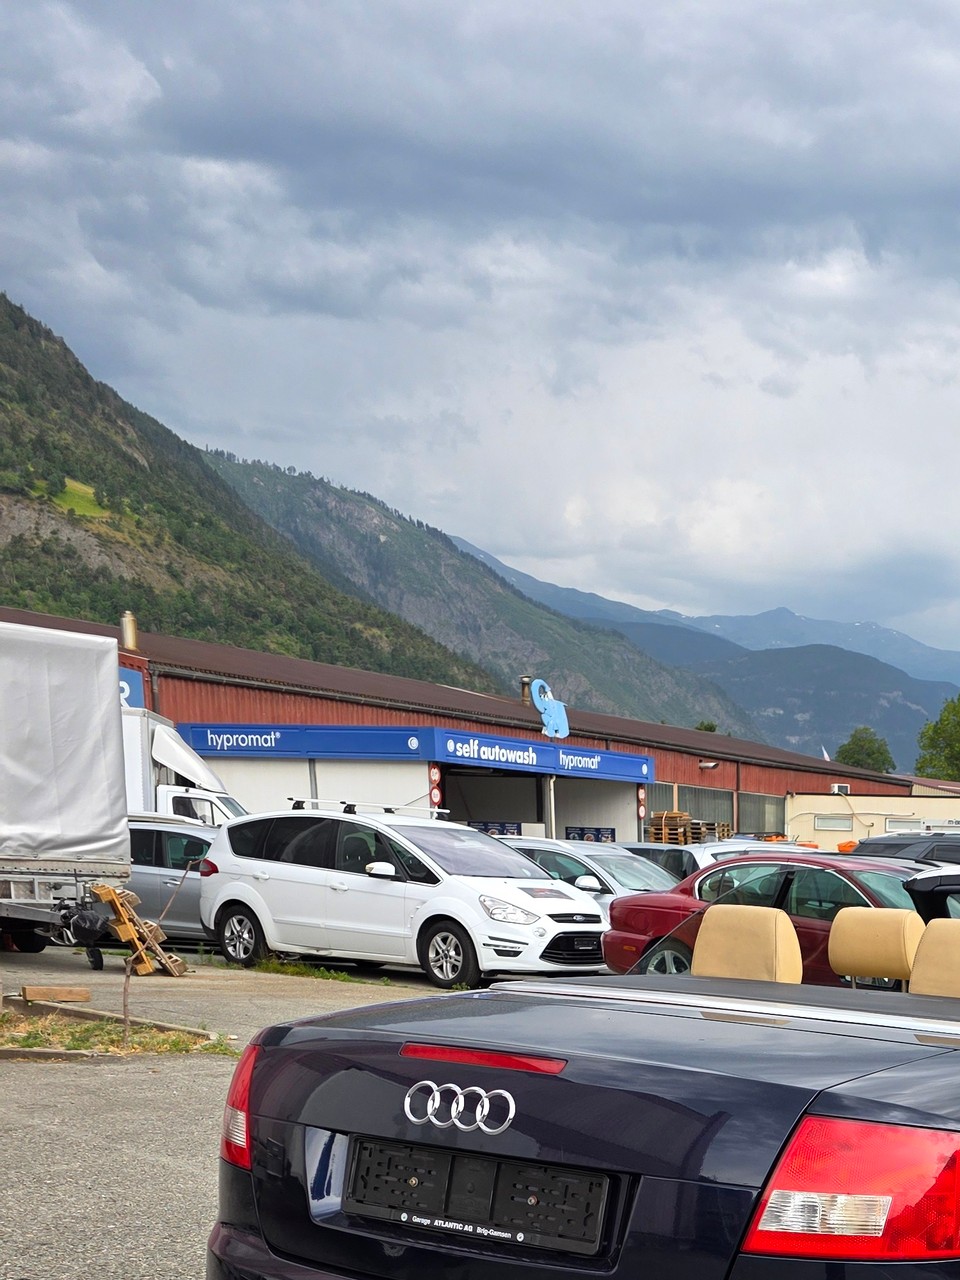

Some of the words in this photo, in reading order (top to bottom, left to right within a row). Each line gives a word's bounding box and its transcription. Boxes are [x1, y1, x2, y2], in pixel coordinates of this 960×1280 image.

[455, 738, 478, 758] self
[480, 744, 537, 764] autowash
[412, 1215, 431, 1225] Garage
[434, 1219, 463, 1230] ATLANTIC
